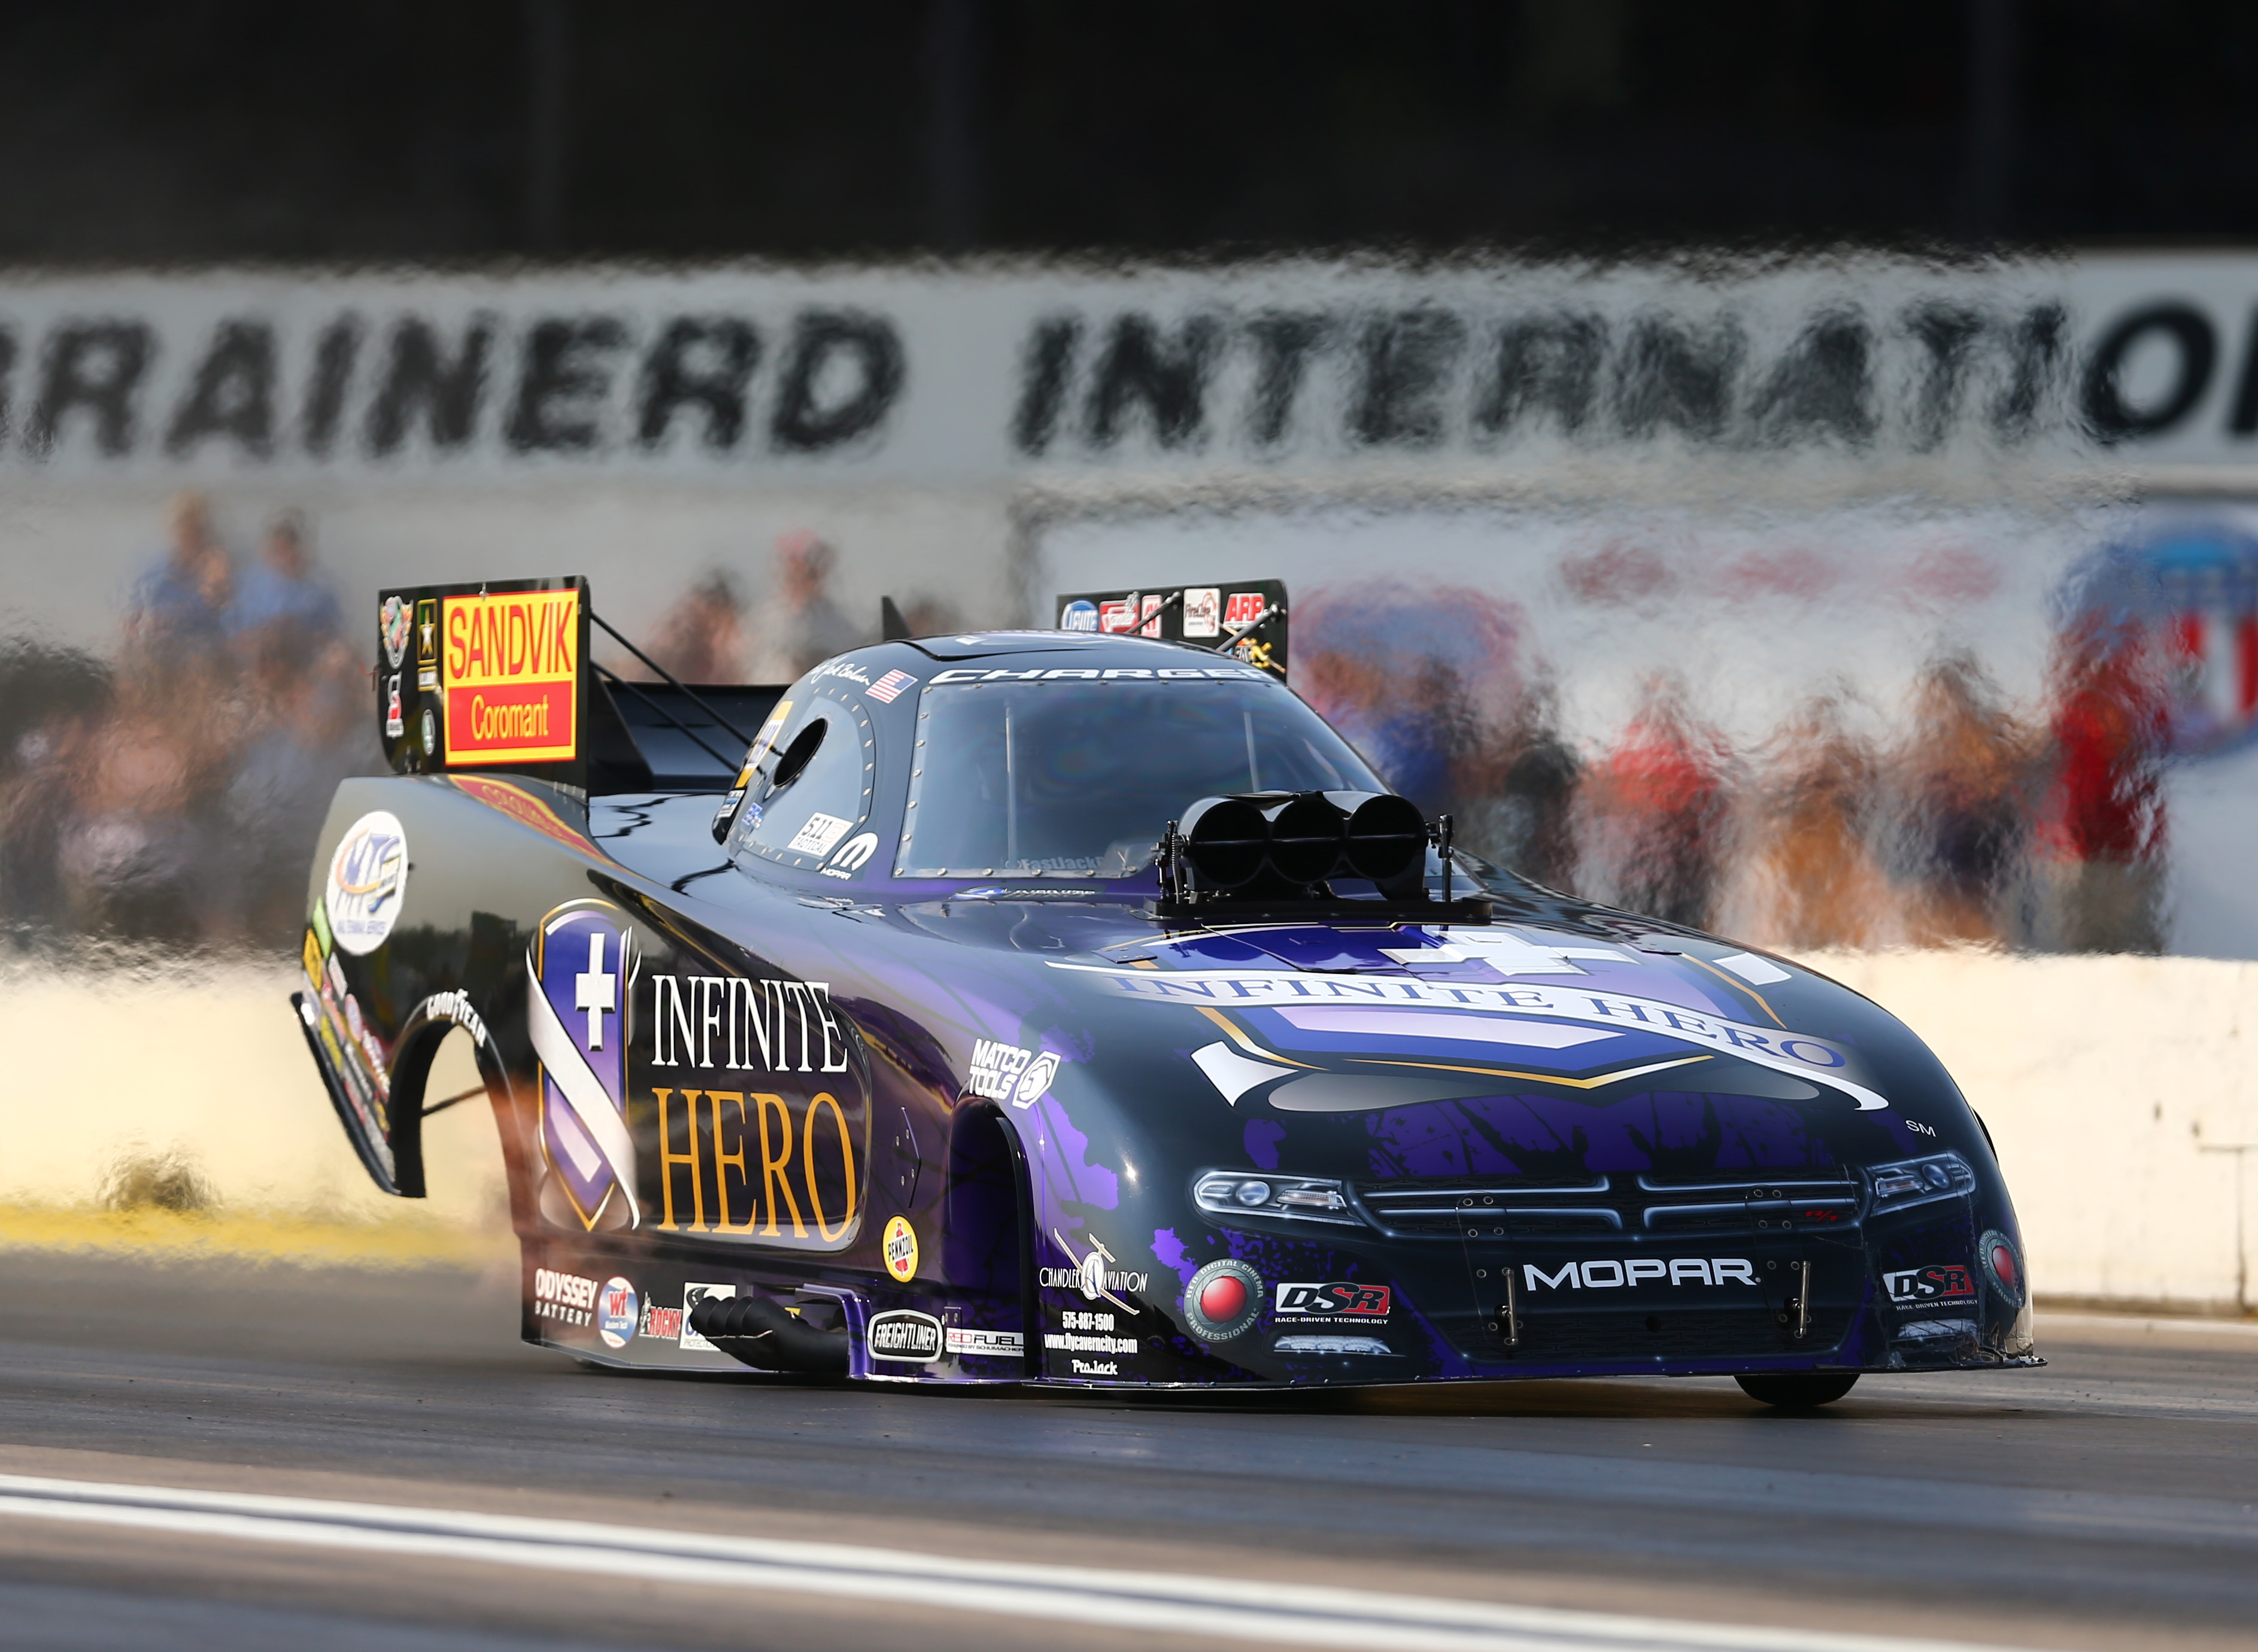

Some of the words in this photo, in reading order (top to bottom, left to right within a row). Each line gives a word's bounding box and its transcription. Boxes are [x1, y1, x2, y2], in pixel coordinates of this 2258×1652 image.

[0, 308, 905, 460] RAINERD
[1012, 297, 2258, 454] INTERNATIO
[450, 600, 573, 679] SANDVIK
[929, 668, 1279, 684] CHARGER
[471, 694, 549, 741] Coromant
[802, 817, 833, 840] 5.11
[793, 837, 827, 854] TACTICAL
[820, 867, 852, 880] MOPAR
[427, 988, 486, 1048] GOODYEAR
[651, 974, 849, 1073] INFINITE
[1113, 974, 1555, 1010] INFINITE
[1588, 996, 1846, 1068] HERO
[971, 1038, 1032, 1075] MATCO
[969, 1065, 1018, 1100] TOOLS
[1905, 1120, 1936, 1137] SM
[651, 1088, 856, 1242] HERO
[888, 1234, 913, 1262] PENNZOIL
[535, 1268, 597, 1310] ODYSSEY
[1039, 1267, 1082, 1289] CHANDLER
[1103, 1271, 1148, 1292] AVIATION
[1186, 1277, 1199, 1298] RED
[1200, 1260, 1238, 1275] DIGITAL
[1242, 1264, 1264, 1298] CINEMA
[1523, 1259, 1757, 1291] MOPAR
[1894, 1265, 1966, 1301] DSR
[535, 1301, 592, 1327] BATTERY
[1280, 1282, 1386, 1315] DSR
[1940, 1299, 1978, 1307] TECHNOLOGY
[648, 1306, 682, 1340] ROCKY
[1063, 1311, 1114, 1331] 575-887-1500
[1186, 1311, 1259, 1340] PROFESSIONAL
[684, 1338, 715, 1348] PROTECTIO
[875, 1322, 936, 1352] FREIGHTLINER
[948, 1332, 972, 1343] RED
[974, 1334, 1024, 1347] FUEL
[1044, 1332, 1137, 1354] www.flycaverncity.com
